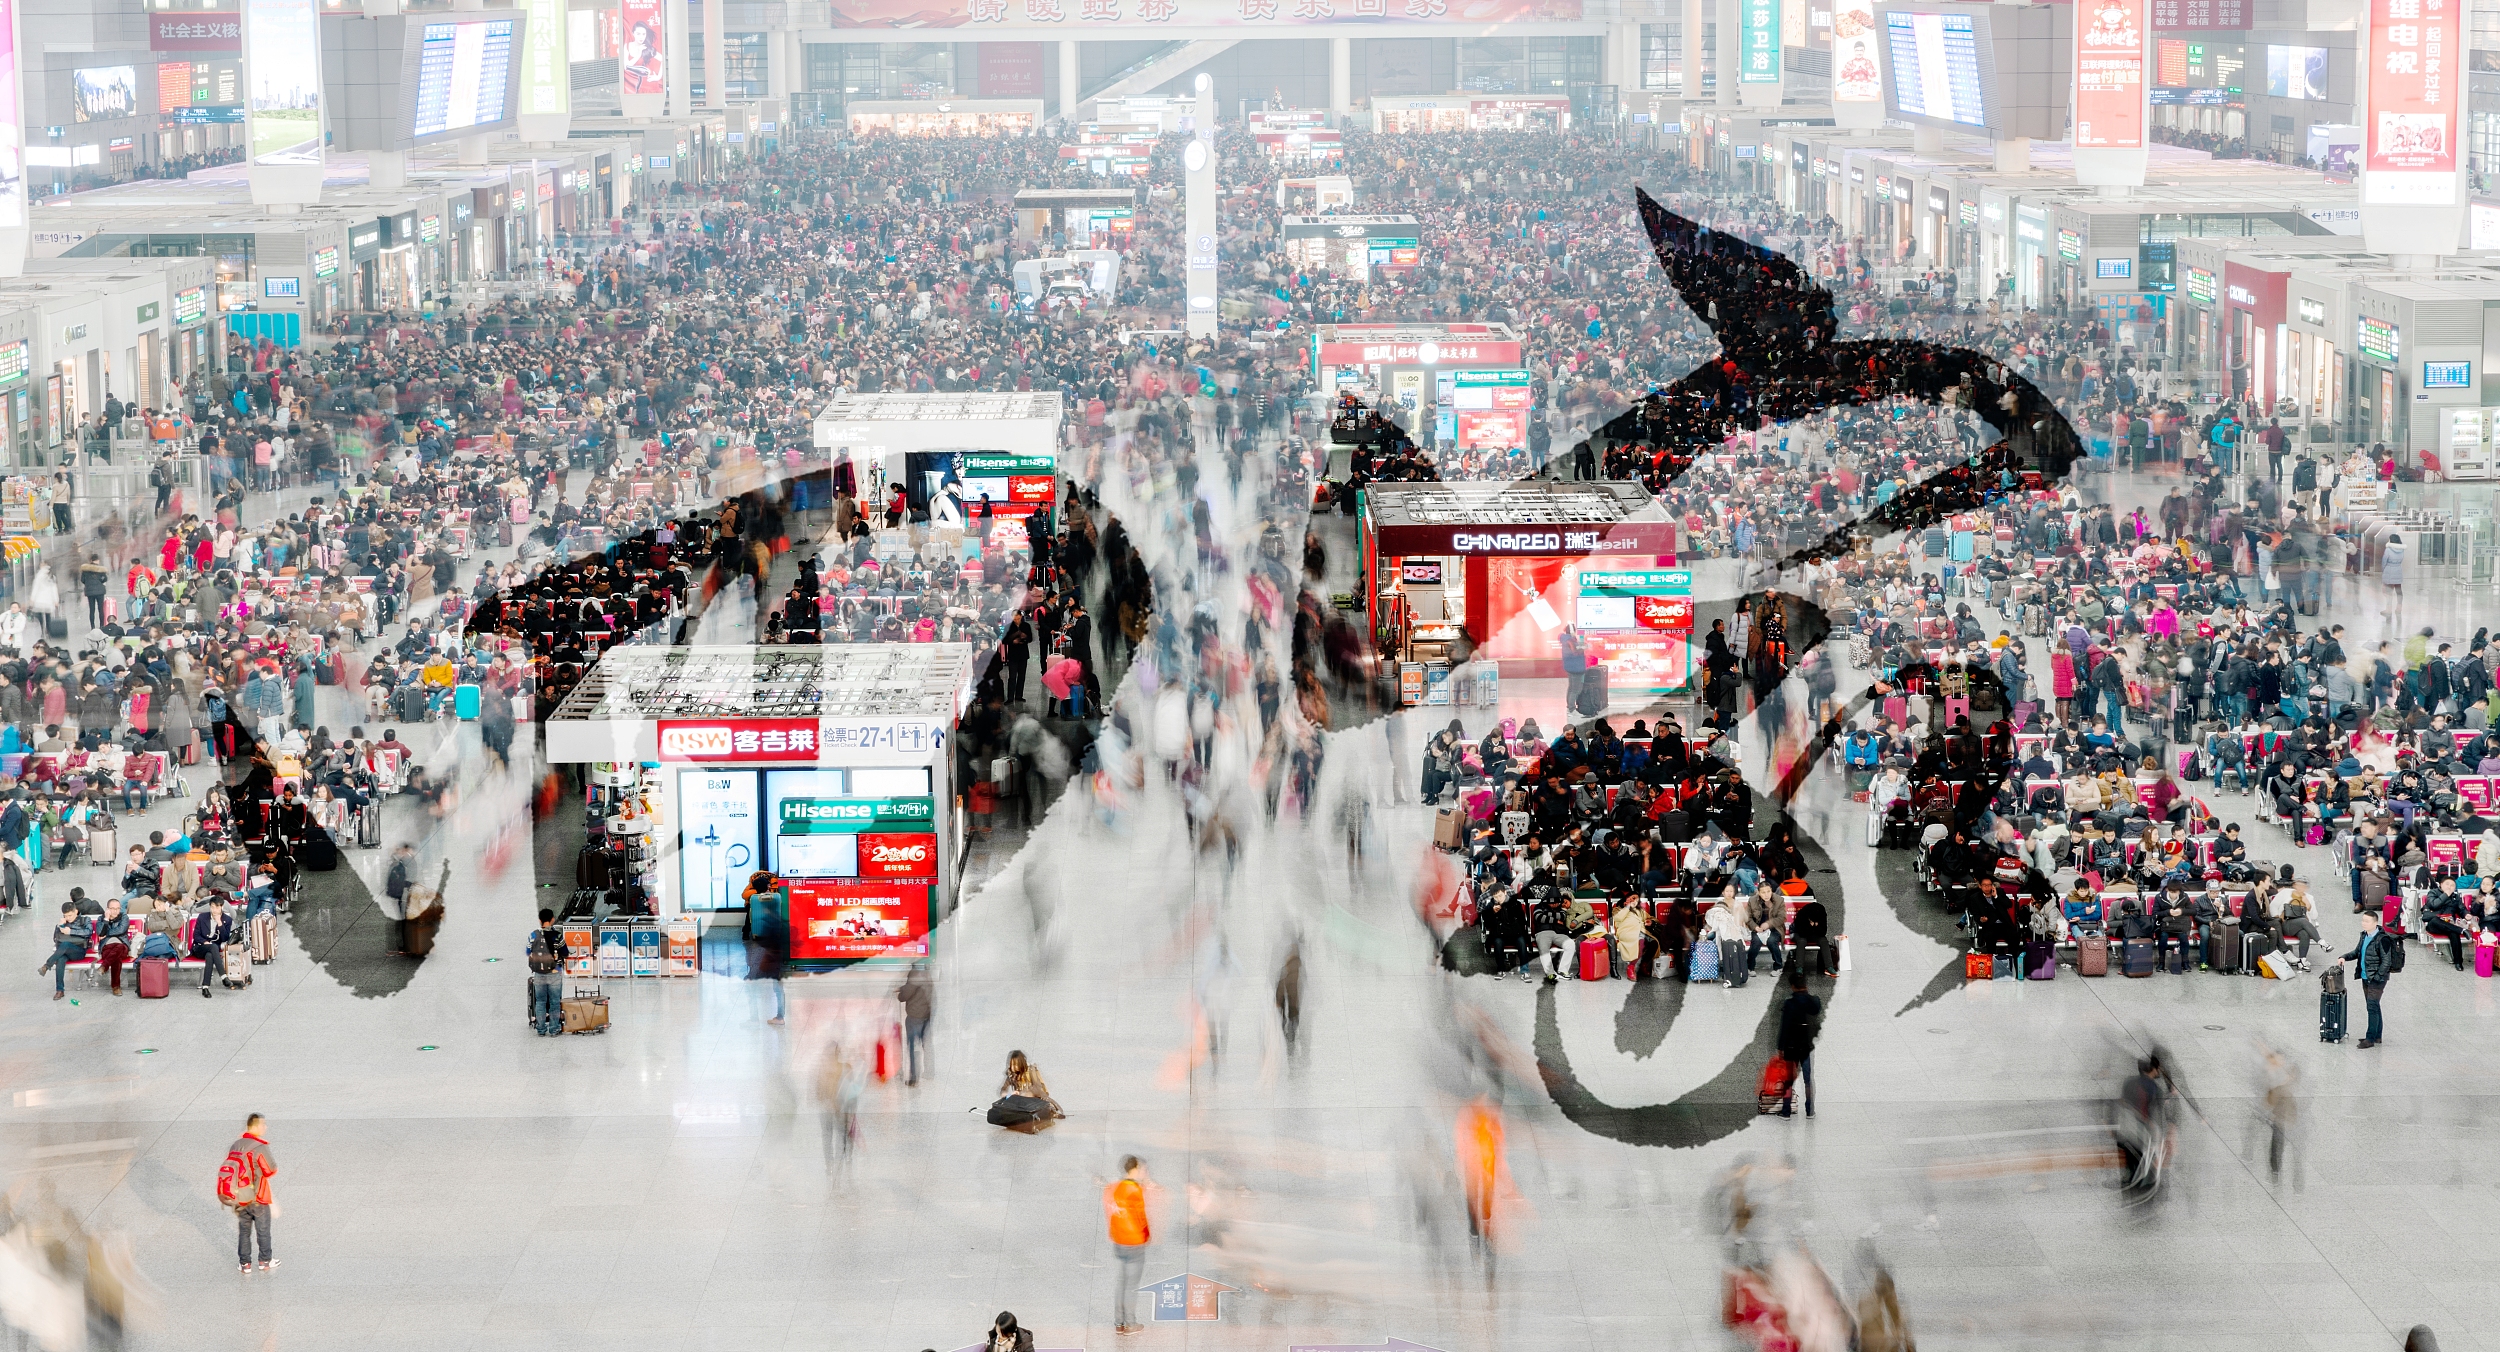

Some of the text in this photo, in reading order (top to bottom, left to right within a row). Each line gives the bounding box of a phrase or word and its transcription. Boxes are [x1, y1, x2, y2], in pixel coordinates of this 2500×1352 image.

[2156, 1, 2241, 9] 民主 文明 和谐
[2156, 9, 2241, 17] 平等 公正 法治
[2156, 18, 2241, 26] 敬业 诚信 友善
[2081, 60, 2140, 70] 互联网理财项目
[2350, 210, 2359, 220] 19
[50, 233, 59, 242] 19
[1457, 371, 1500, 380] Hisense
[966, 458, 1018, 467] Hisense
[1582, 573, 1647, 585] Hisense
[1645, 604, 1687, 617] 2016
[733, 729, 814, 753] 客吉莱
[823, 726, 894, 748] 检票口 27-1
[708, 780, 731, 790] B&W
[784, 803, 871, 818] Hisense
[870, 845, 926, 862] 2016
[884, 864, 912, 872] 新年快乐
[817, 897, 901, 907] 海信 ULED 超画质电视
